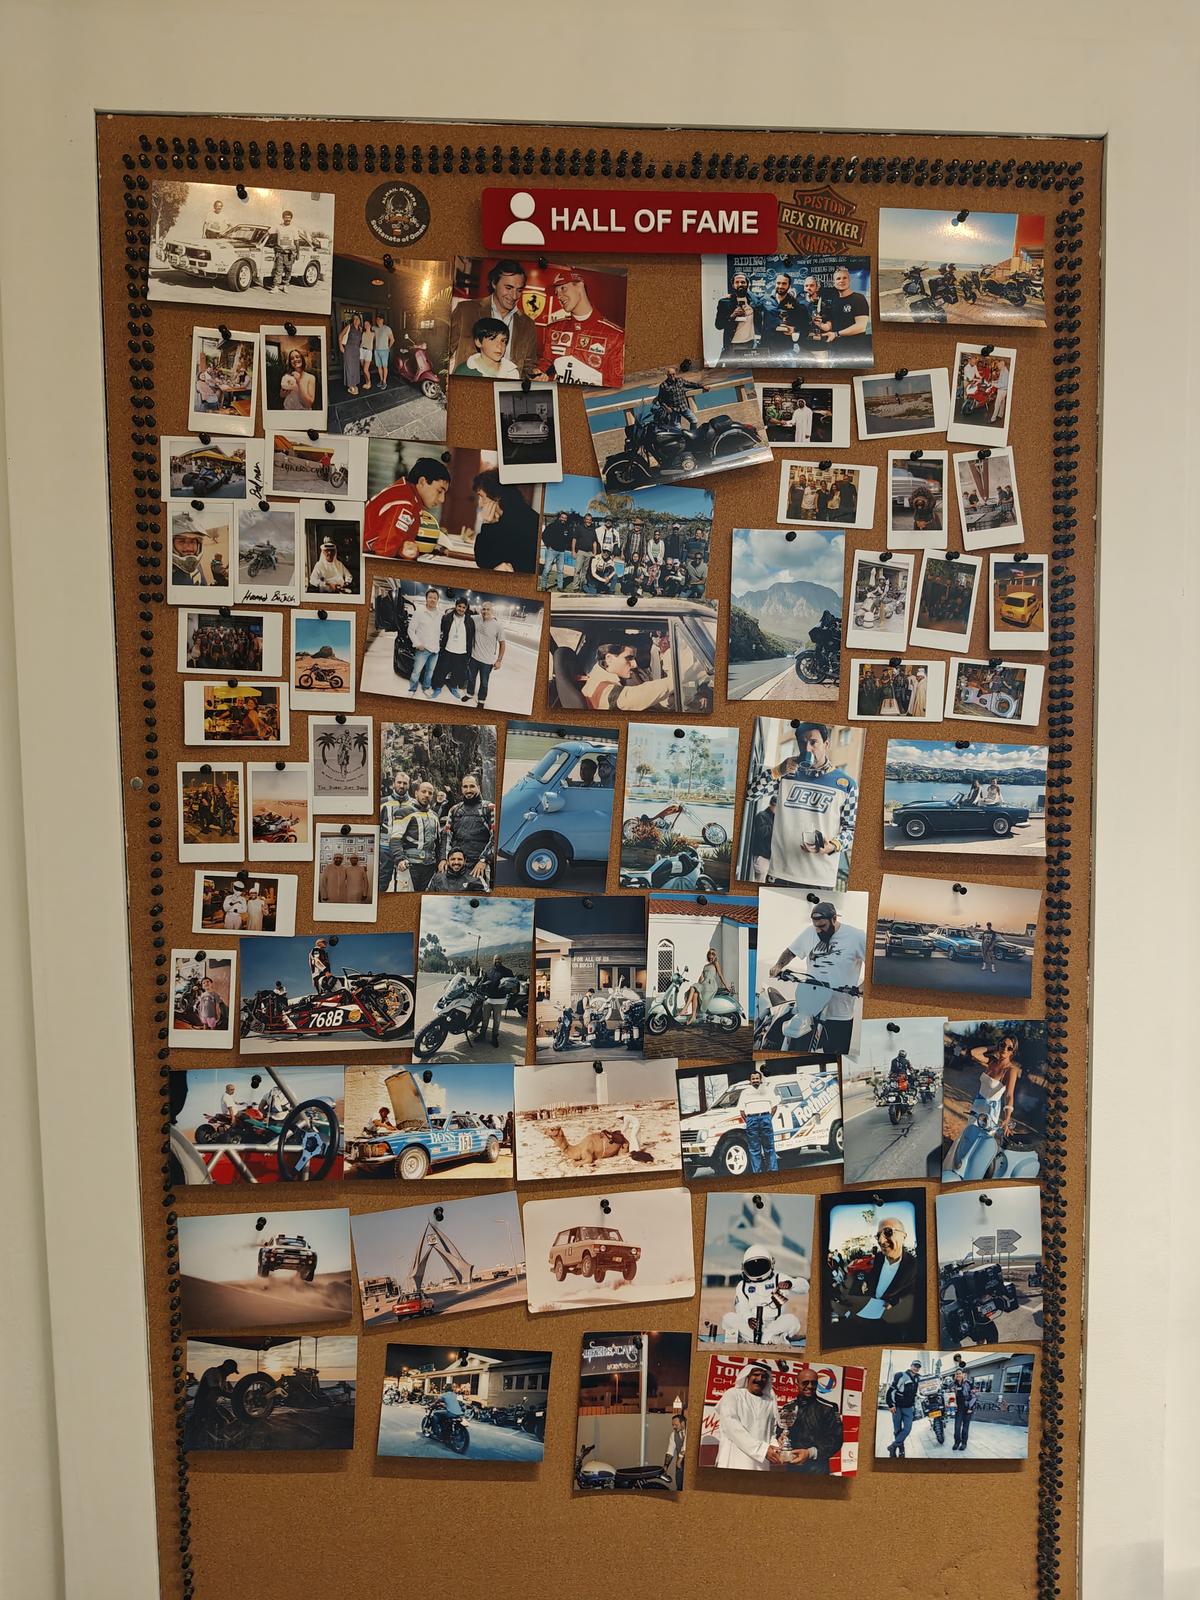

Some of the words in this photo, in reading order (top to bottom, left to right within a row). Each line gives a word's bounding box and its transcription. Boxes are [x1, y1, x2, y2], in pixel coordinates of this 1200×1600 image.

[804, 196, 847, 216] PISTON
[551, 207, 627, 233] HALL
[634, 208, 673, 234] OF
[682, 209, 760, 235] FAME
[781, 208, 806, 227] REX
[806, 214, 860, 241] STRYKER
[796, 232, 837, 257] KINGS
[784, 783, 836, 814] DEUS
[308, 1009, 344, 1029] 768B
[777, 1112, 785, 1128] 1
[430, 1132, 456, 1144] BOSS
